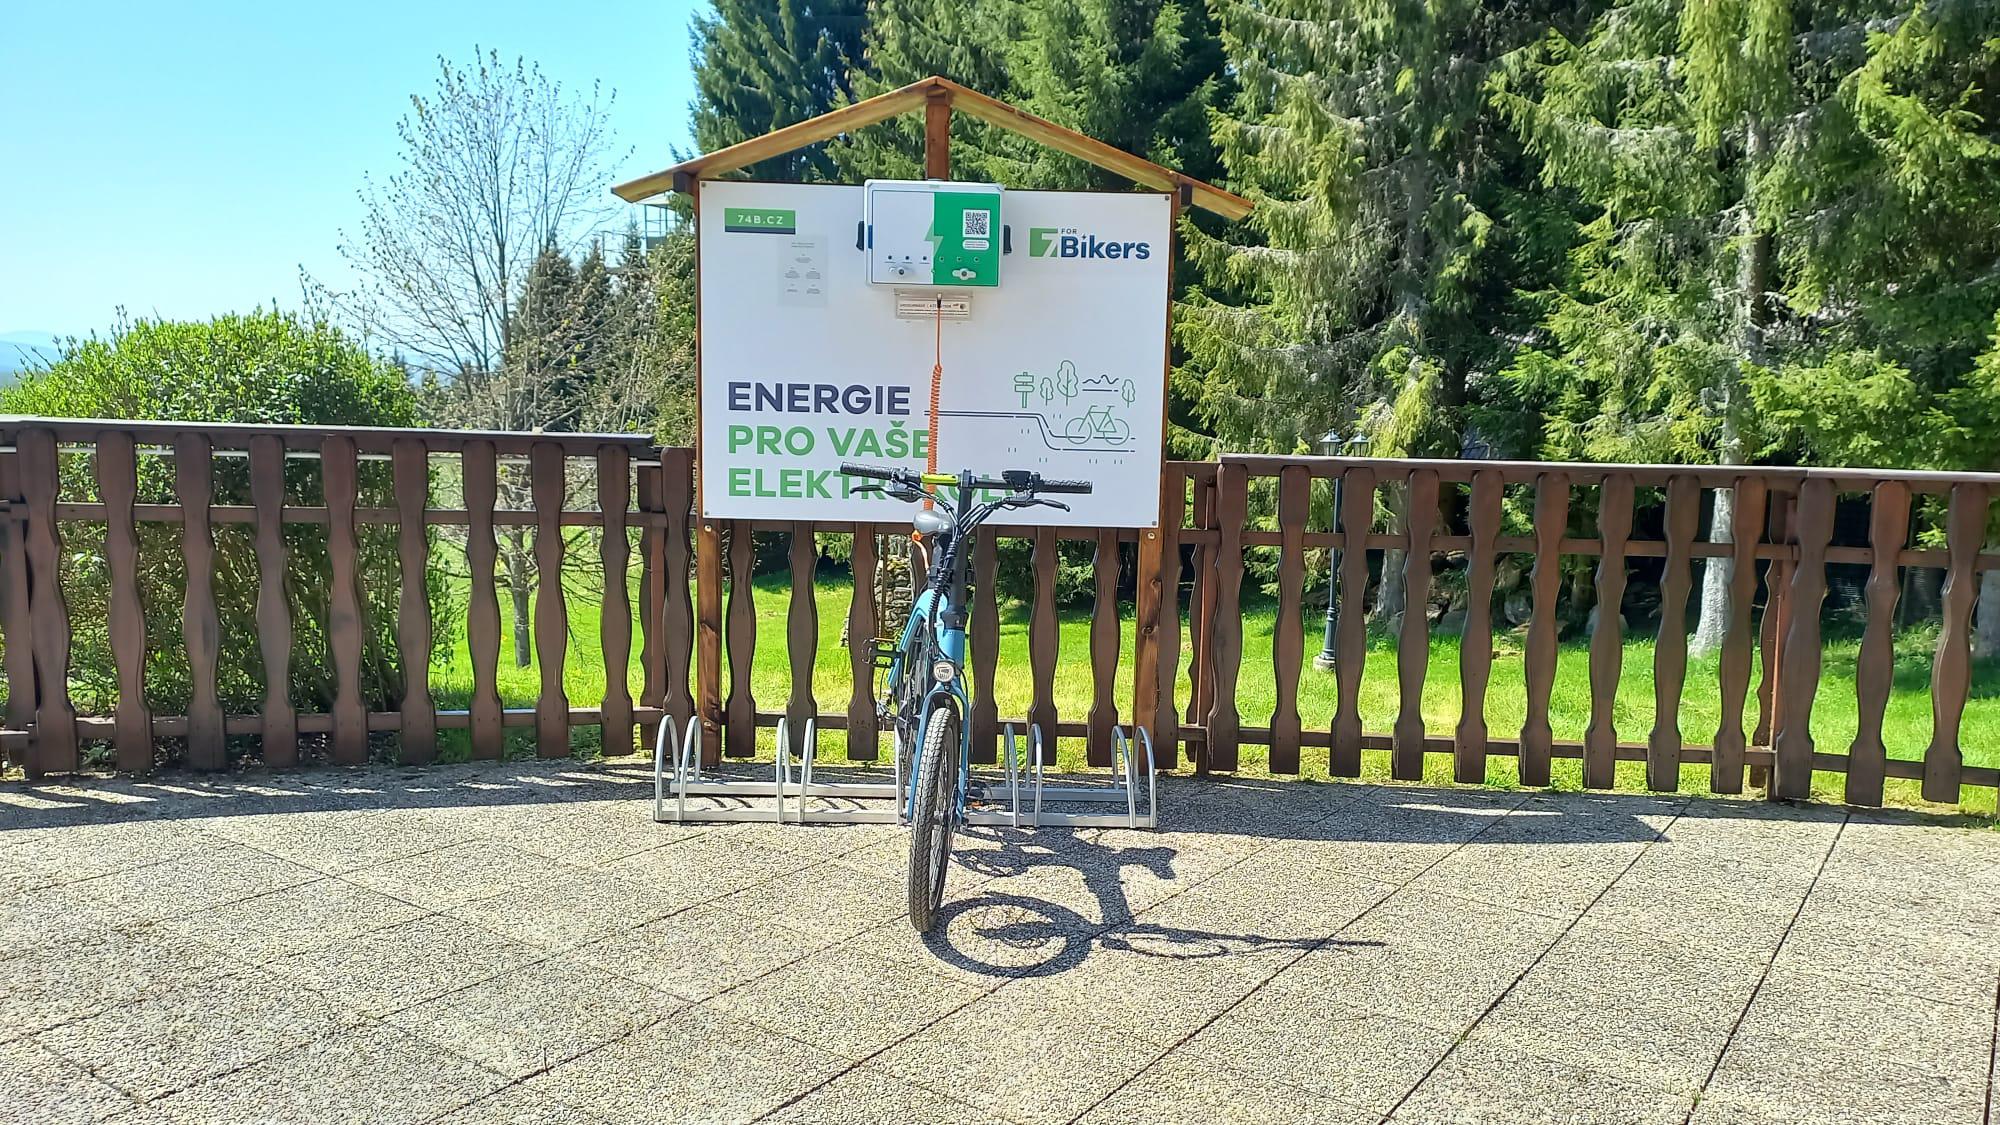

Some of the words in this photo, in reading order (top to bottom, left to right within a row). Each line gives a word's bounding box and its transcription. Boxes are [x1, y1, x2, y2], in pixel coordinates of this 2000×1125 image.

[737, 214, 784, 225] 74B.CZ
[1060, 234, 1150, 260] Bikers
[728, 382, 911, 415] ENERGIE
[728, 425, 815, 456] PRO
[827, 420, 929, 459] VAŠE
